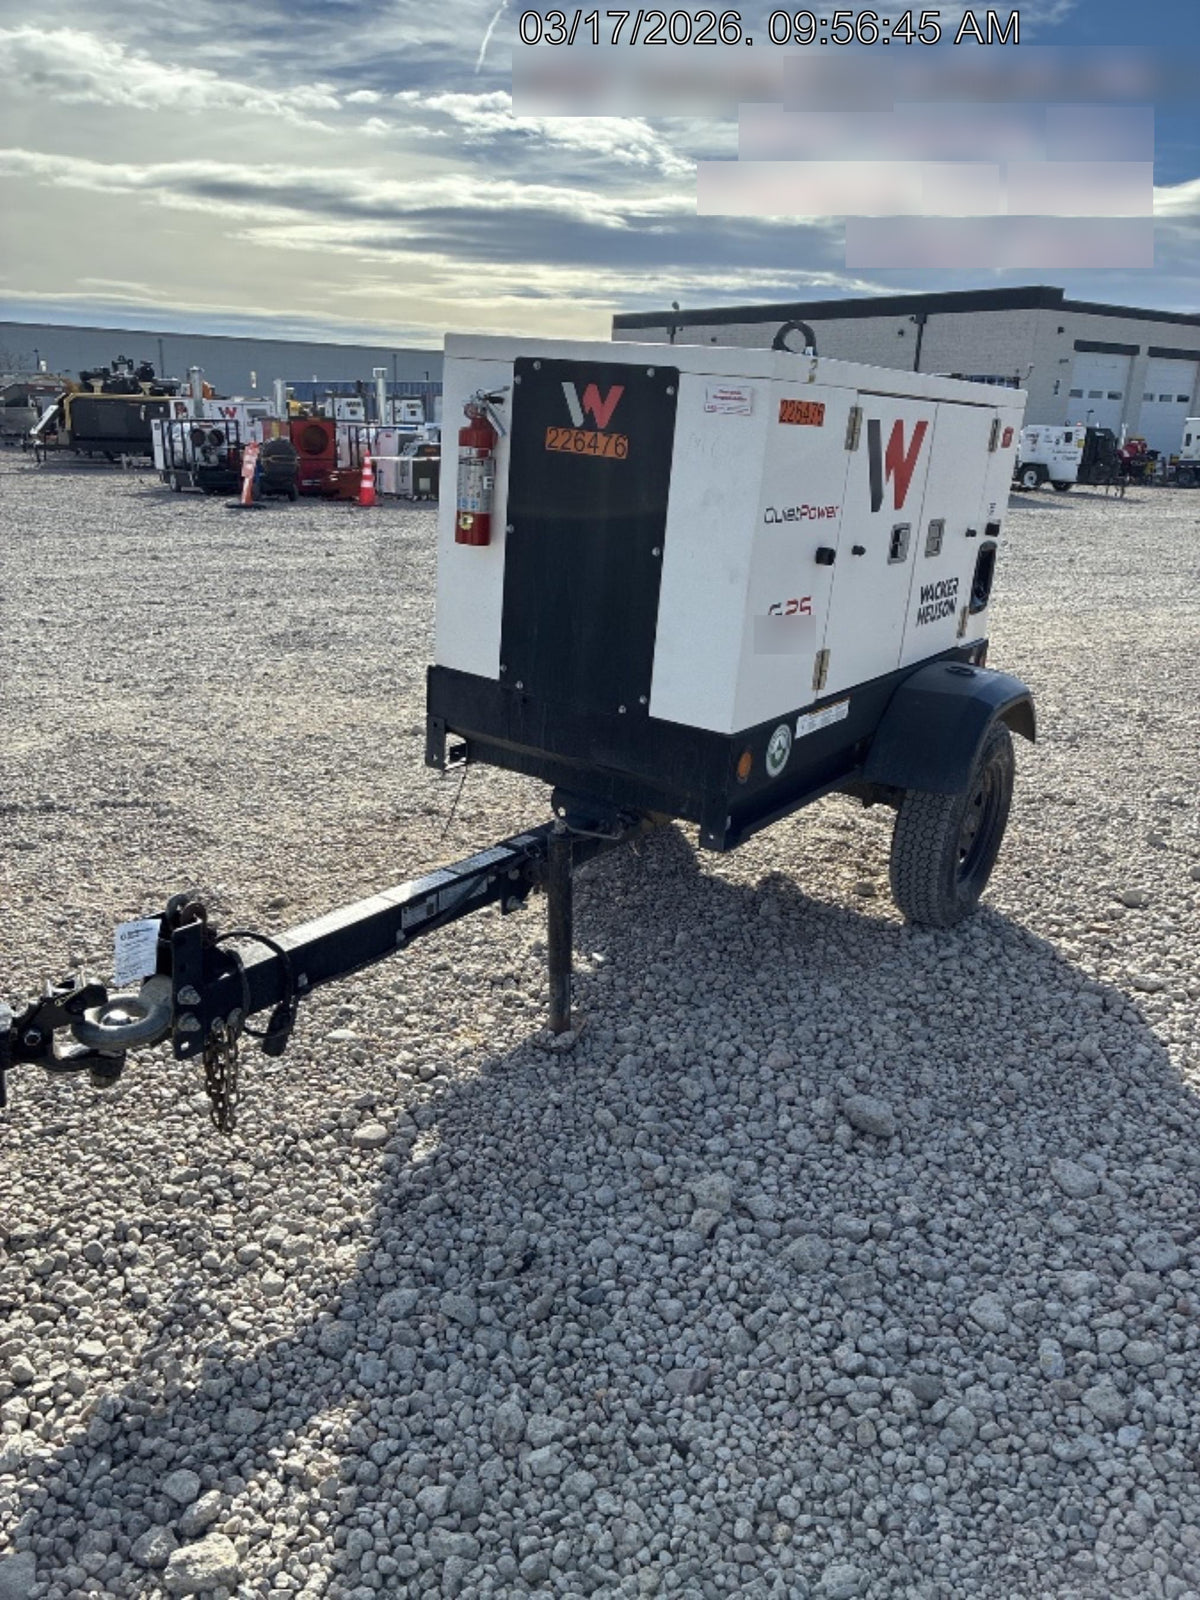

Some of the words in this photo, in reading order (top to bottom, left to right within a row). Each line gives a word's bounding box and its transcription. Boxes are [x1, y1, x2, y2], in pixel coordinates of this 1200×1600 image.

[546, 427, 627, 458] 226476
[920, 577, 959, 605] WACKER
[915, 597, 958, 627] NEUSON
